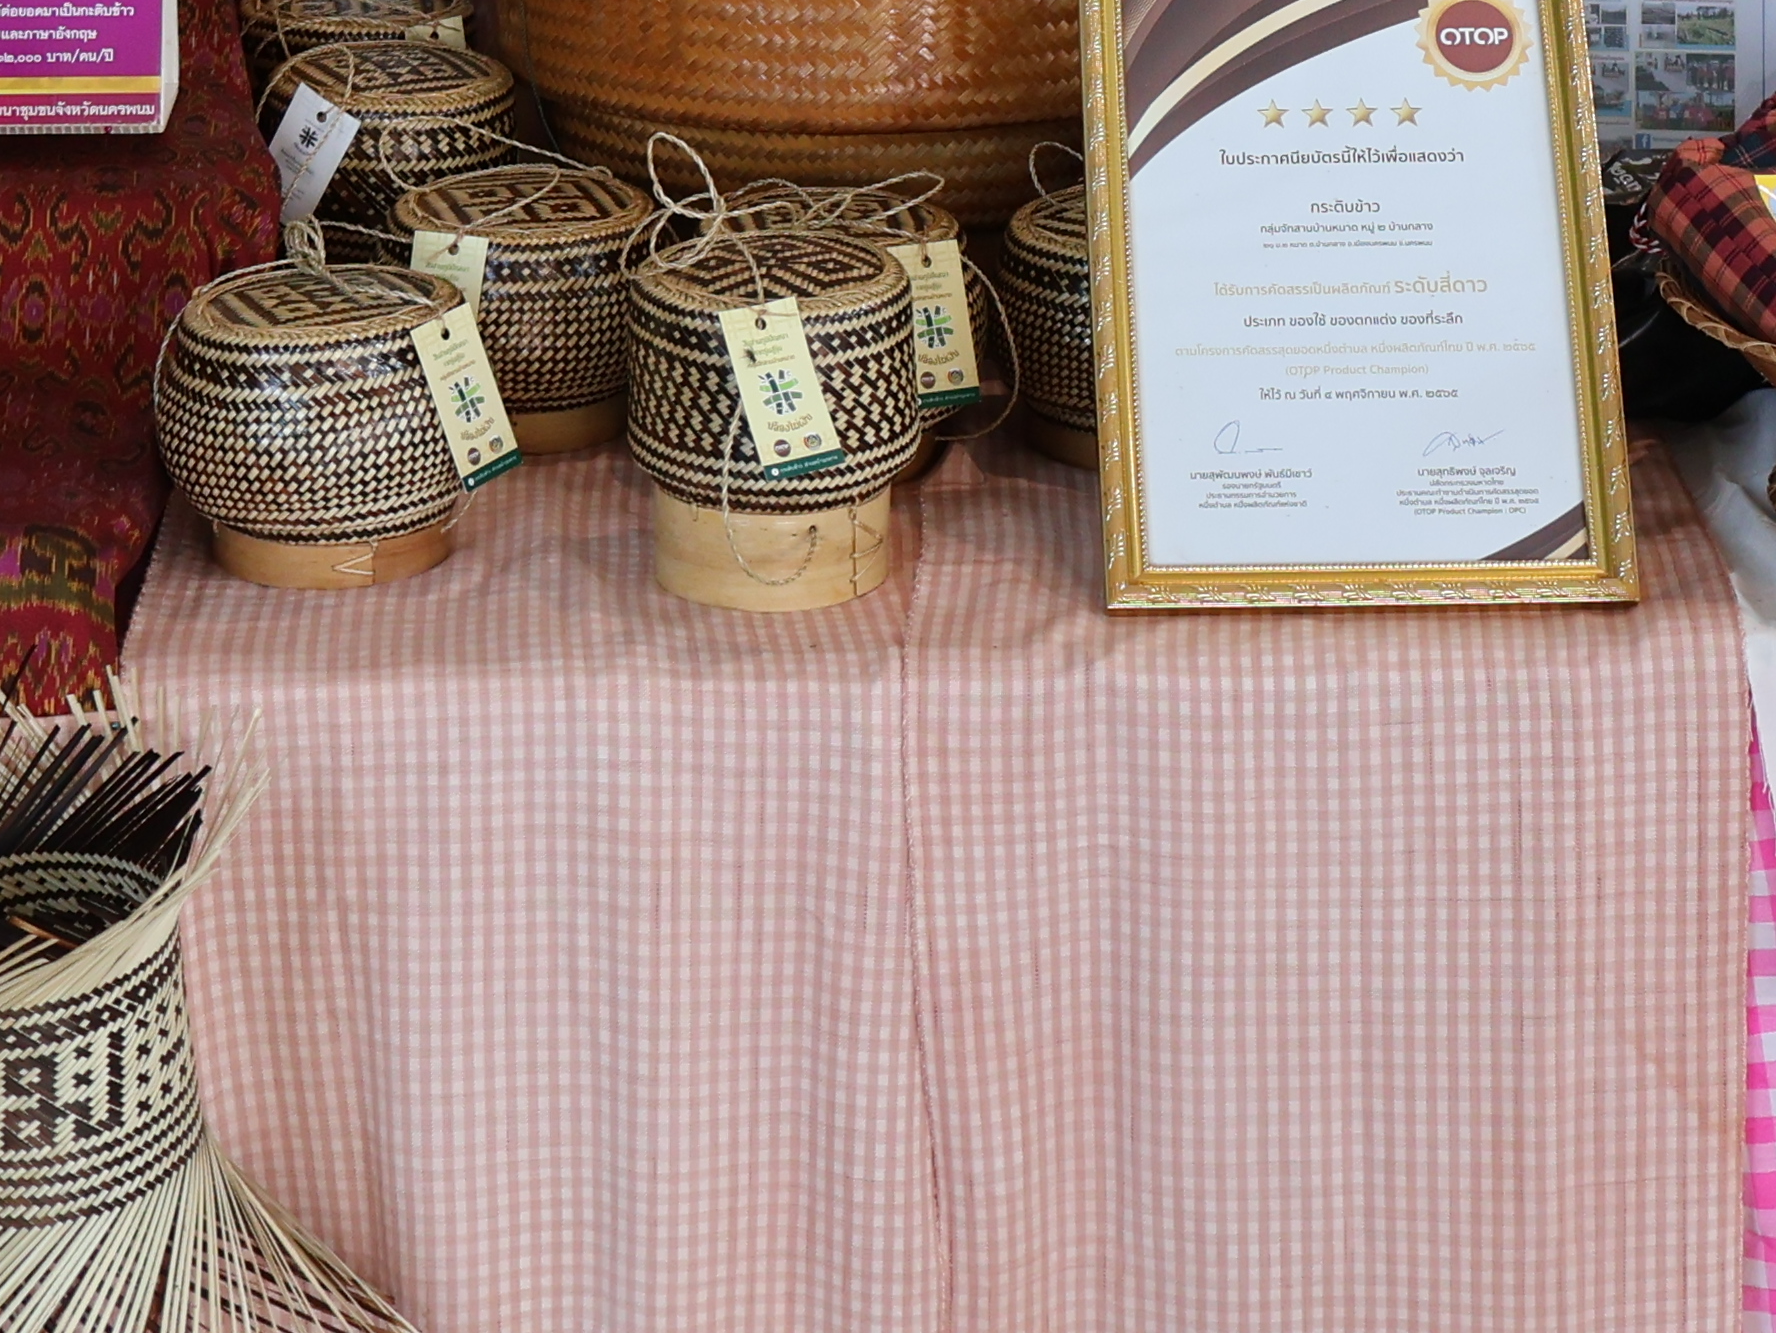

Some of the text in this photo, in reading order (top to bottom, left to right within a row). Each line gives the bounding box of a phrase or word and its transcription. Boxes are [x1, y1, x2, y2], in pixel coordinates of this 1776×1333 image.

[1439, 27, 1509, 46] OTOP
[47, 48, 114, 64] บาท/คน/ปี
[1219, 145, 1464, 165] ใบประกาศนียบัตรนี้ให้ไว้เพื่อแสดงว่า
[1311, 199, 1380, 213] กระติบข้าว
[1361, 222, 1374, 234] หมู่
[1389, 221, 1433, 231] บ้านกลาง
[1214, 273, 1487, 296] ได้รับการคัดสรรเป็นผลิตภัณฑ์ ระดับสี่ดาว
[1244, 310, 1463, 327] ประเภท ของใช้ ของตกแต่ง ของที่ระลึก
[1466, 341, 1474, 352] ปี
[1286, 364, 1428, 379] (OTOP Product Champion)
[1259, 387, 1281, 400] ให้ไว้
[1285, 392, 1296, 400] ณ
[1299, 386, 1321, 399] วันที่
[1335, 389, 1395, 401] พฤศจิกายน
[1399, 390, 1422, 398] พ.ศ.
